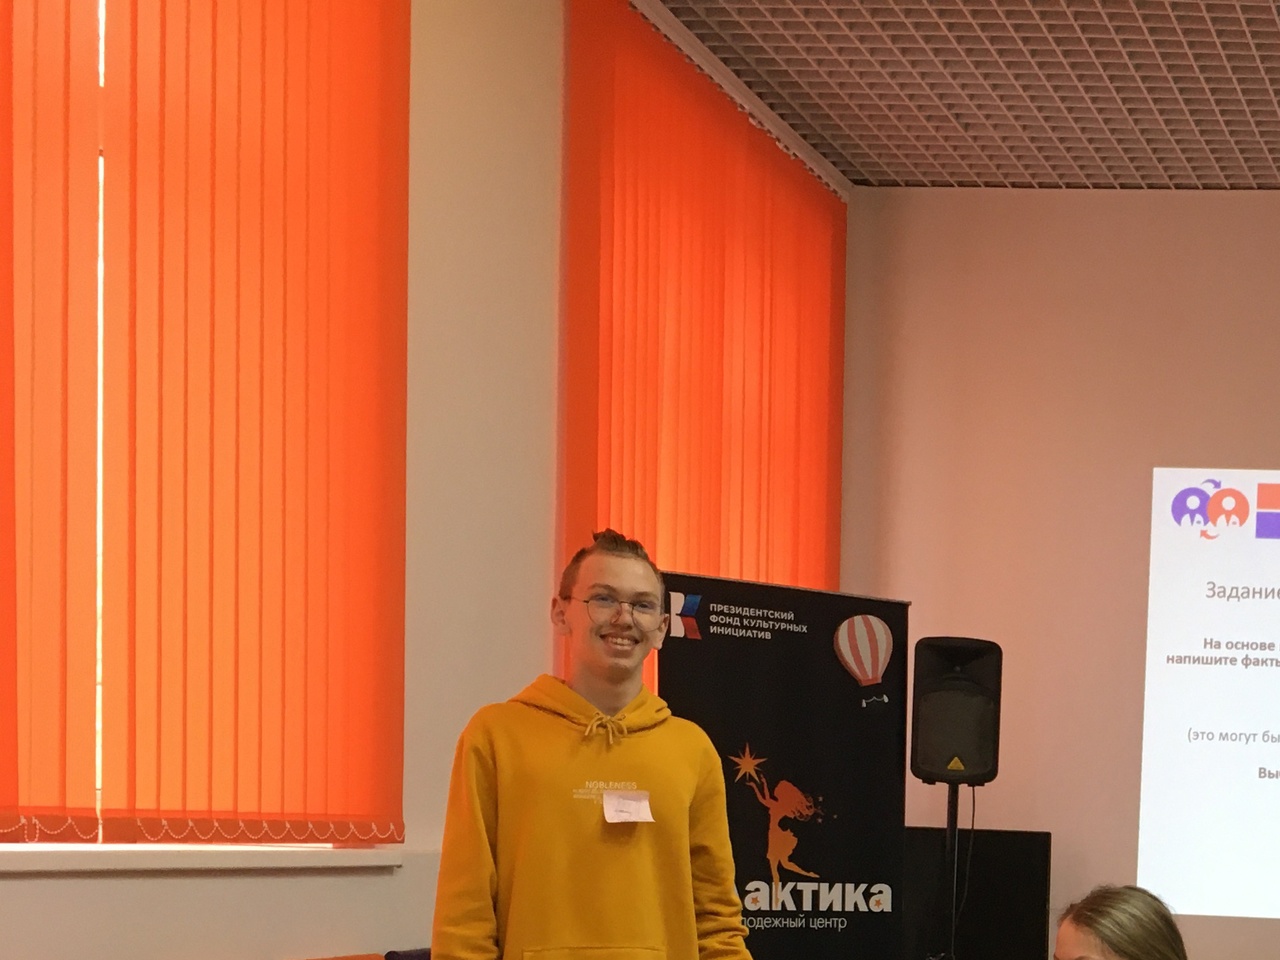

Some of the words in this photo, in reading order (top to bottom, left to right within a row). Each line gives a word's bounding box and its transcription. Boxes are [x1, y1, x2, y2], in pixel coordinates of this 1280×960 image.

[709, 603, 795, 621] ПРЕЗИДЕНТСКИЙ
[709, 614, 740, 626] ФОНД
[743, 618, 808, 633] КУЛЬТУРНЫХ
[709, 625, 772, 640] ИНИЦИАТИВ
[1203, 637, 1222, 650] На
[1225, 639, 1276, 651] основе
[1166, 654, 1238, 666] напишите
[1187, 728, 1215, 742] (это
[1218, 731, 1258, 745] могут
[744, 880, 893, 912] актика
[809, 917, 848, 932] центр
